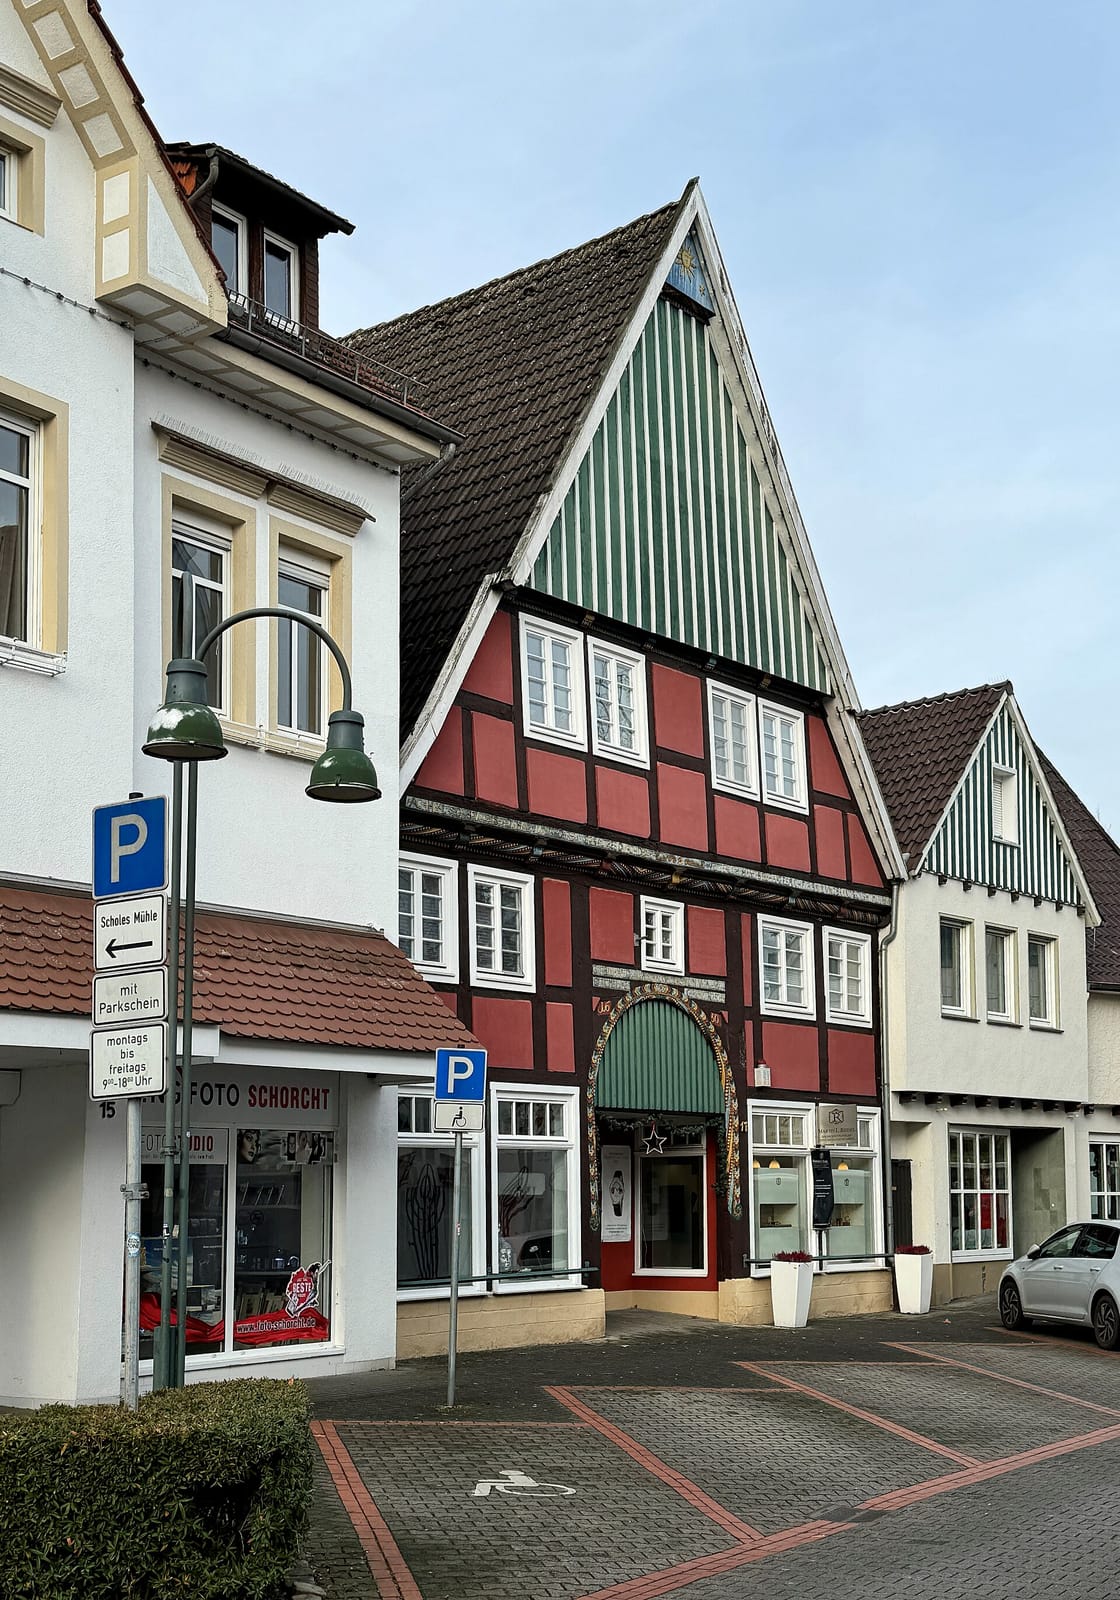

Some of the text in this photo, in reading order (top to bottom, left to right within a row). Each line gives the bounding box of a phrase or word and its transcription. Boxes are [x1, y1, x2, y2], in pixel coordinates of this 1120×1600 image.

[110, 813, 149, 883] P
[100, 910, 158, 928] Scholes Mühle
[120, 983, 138, 996] mit
[99, 997, 160, 1015] Parkschein
[106, 1032, 148, 1047] montags
[120, 1048, 135, 1060] bis
[109, 1062, 146, 1075] freitags
[447, 1056, 474, 1094] P
[135, 1075, 153, 1087] Uhr
[248, 1085, 330, 1110] SCHORCHT
[99, 1102, 116, 1119] 15
